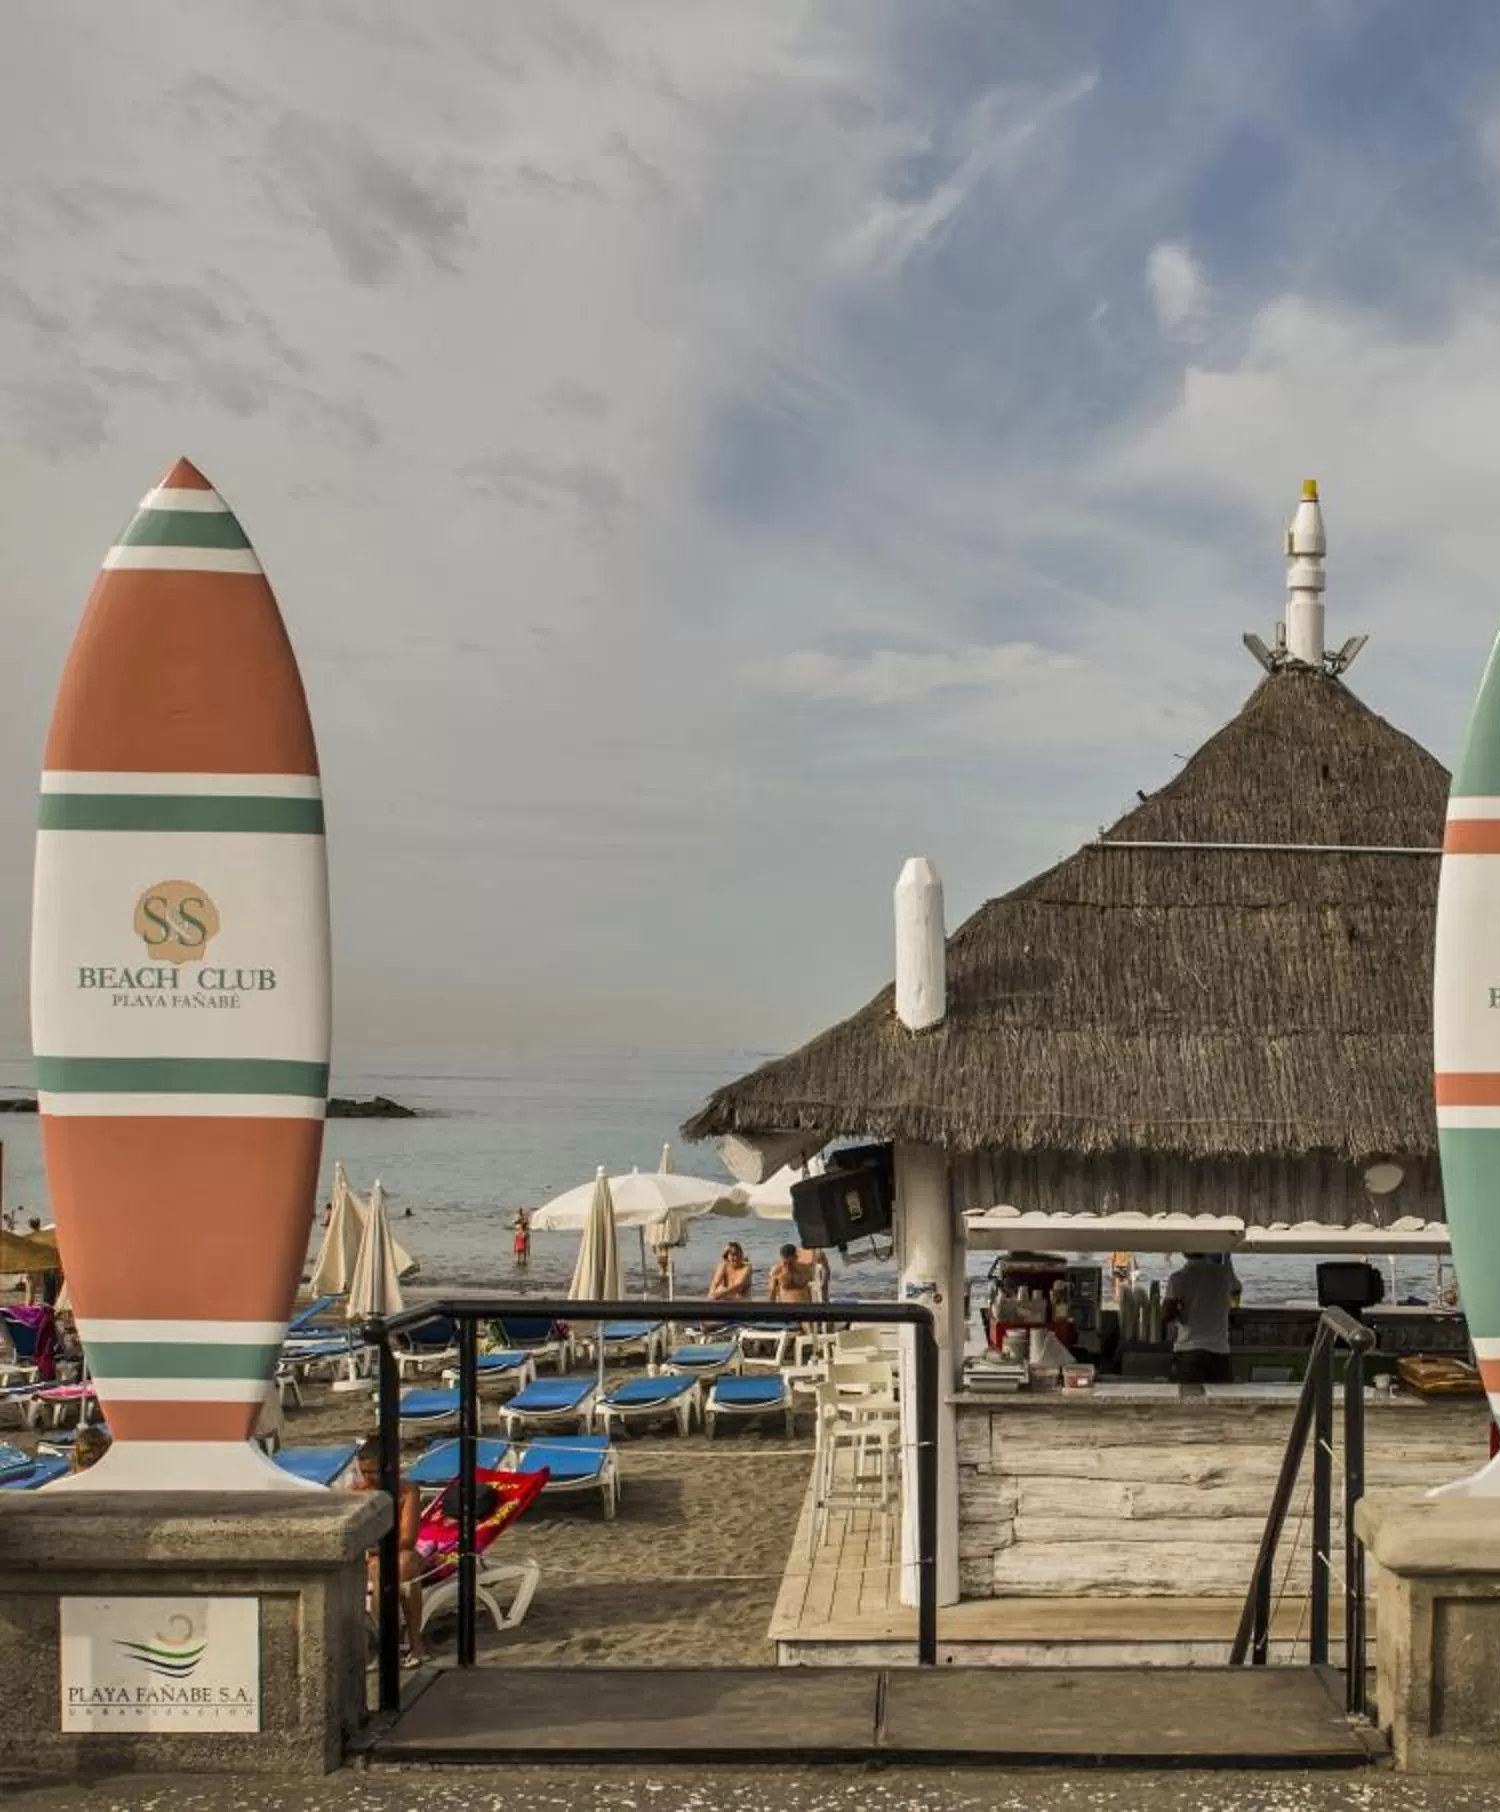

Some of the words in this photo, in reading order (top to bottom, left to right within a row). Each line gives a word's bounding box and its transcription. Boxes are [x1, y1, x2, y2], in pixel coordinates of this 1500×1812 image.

[77, 967, 179, 989] BEACH
[197, 968, 276, 991] CLUB
[112, 993, 166, 1008] PLAYA
[68, 1687, 130, 1702] PLAYA
